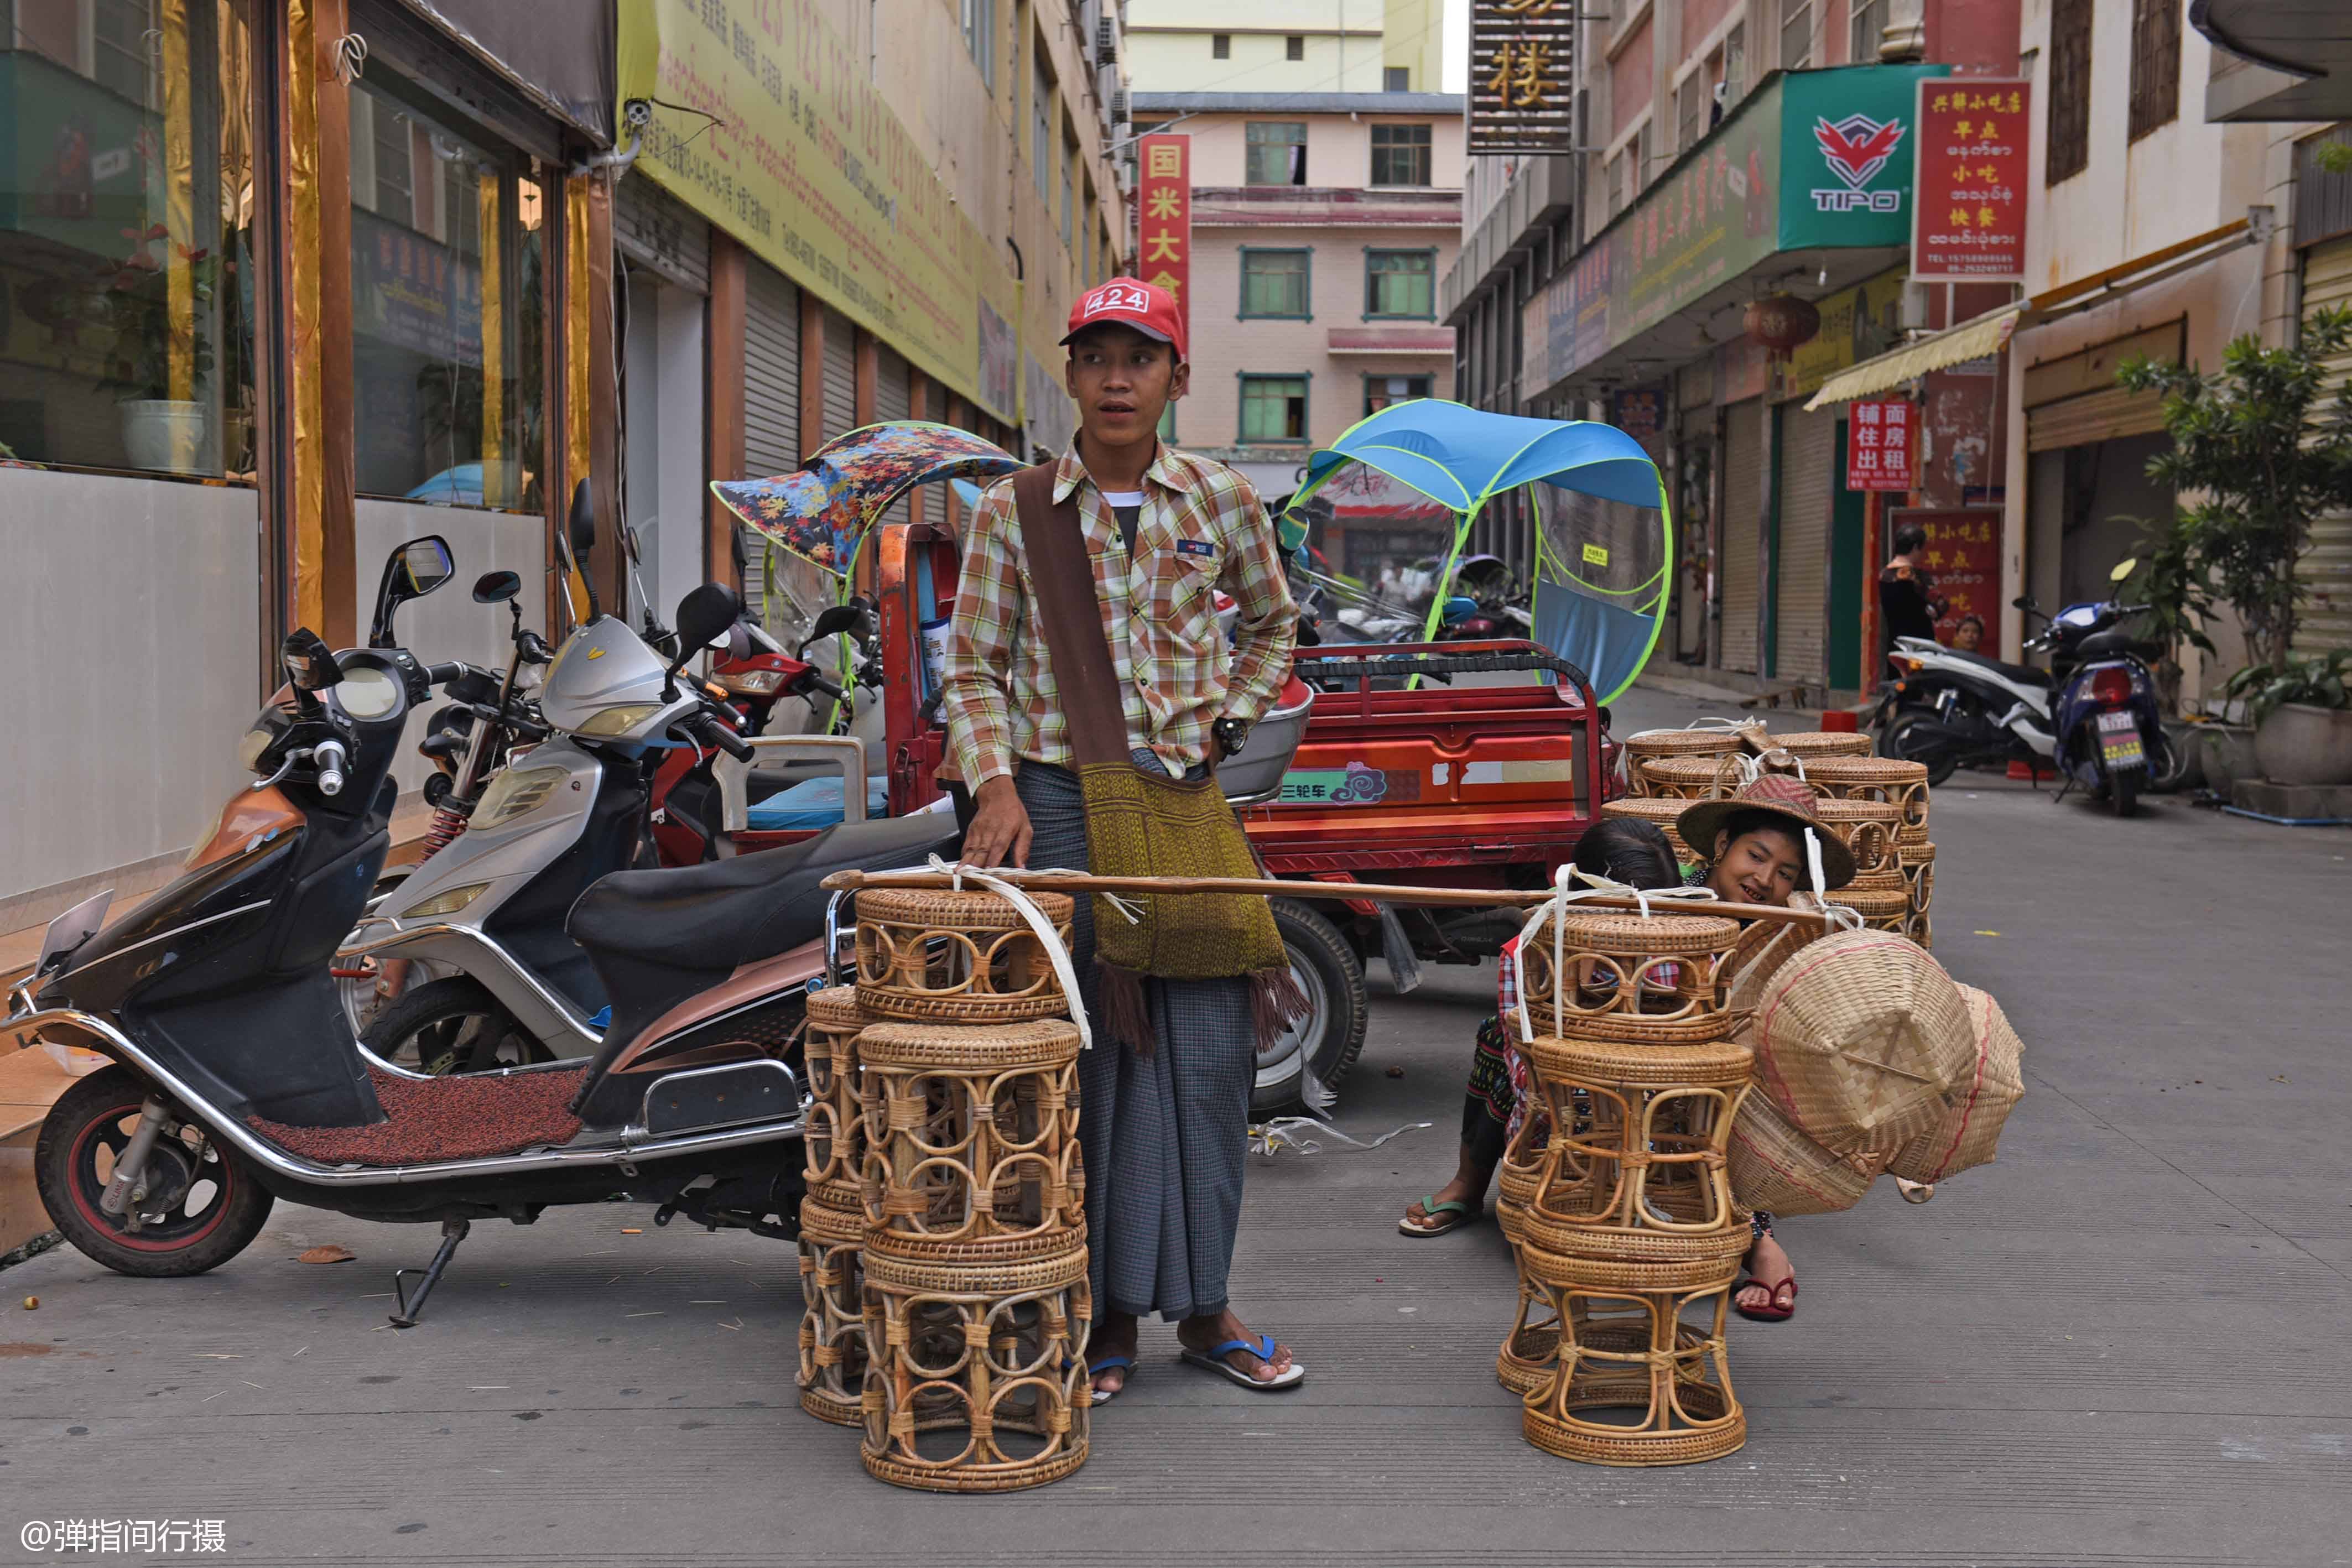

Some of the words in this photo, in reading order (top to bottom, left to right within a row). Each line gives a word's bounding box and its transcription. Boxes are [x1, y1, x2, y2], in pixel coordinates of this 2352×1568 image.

[1810, 189, 1900, 212] TIPO
[1088, 288, 1144, 310] 424
[1857, 426, 1906, 447] 住房
[1857, 449, 1906, 470] 出租
[1282, 784, 1326, 798] 三轮车
